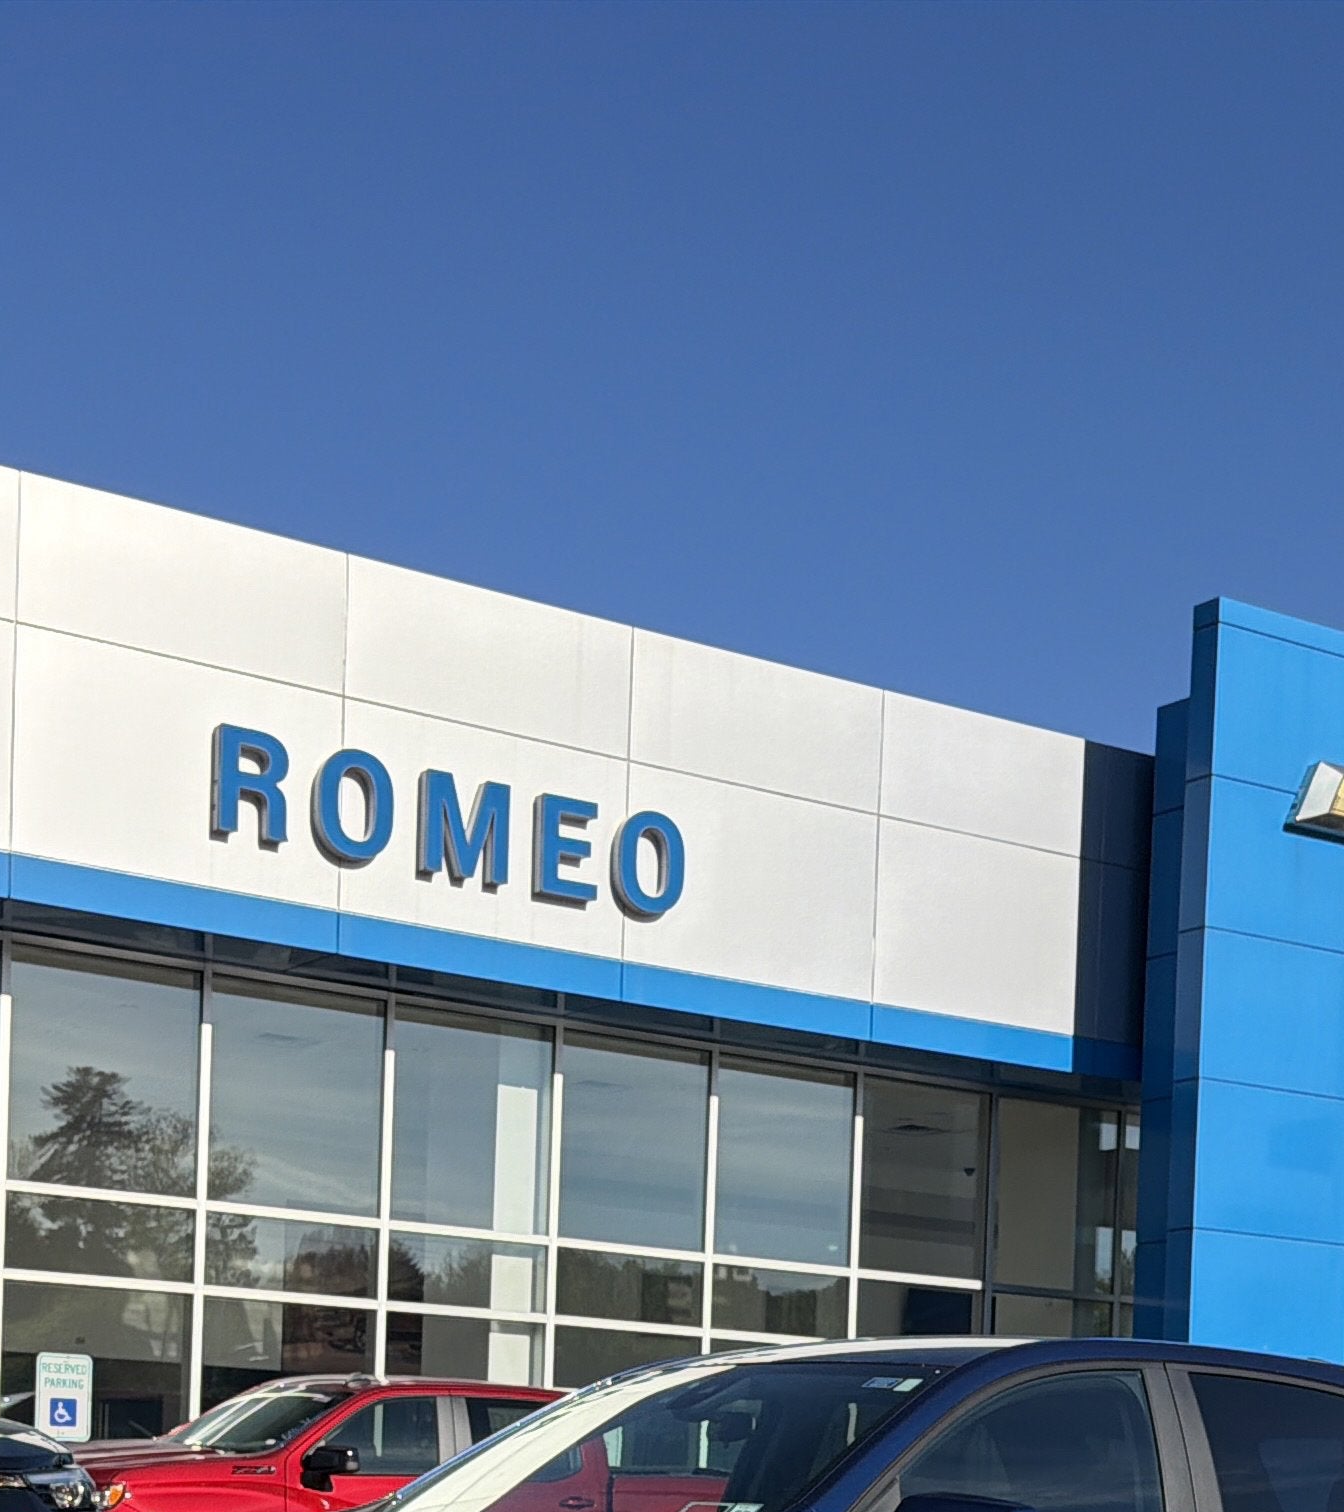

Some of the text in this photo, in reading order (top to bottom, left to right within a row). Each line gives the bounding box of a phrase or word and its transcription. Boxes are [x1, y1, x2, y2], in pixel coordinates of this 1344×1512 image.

[210, 723, 685, 921] ROMEO
[41, 1362, 87, 1375] RESERVED
[44, 1376, 85, 1390] PARKING
